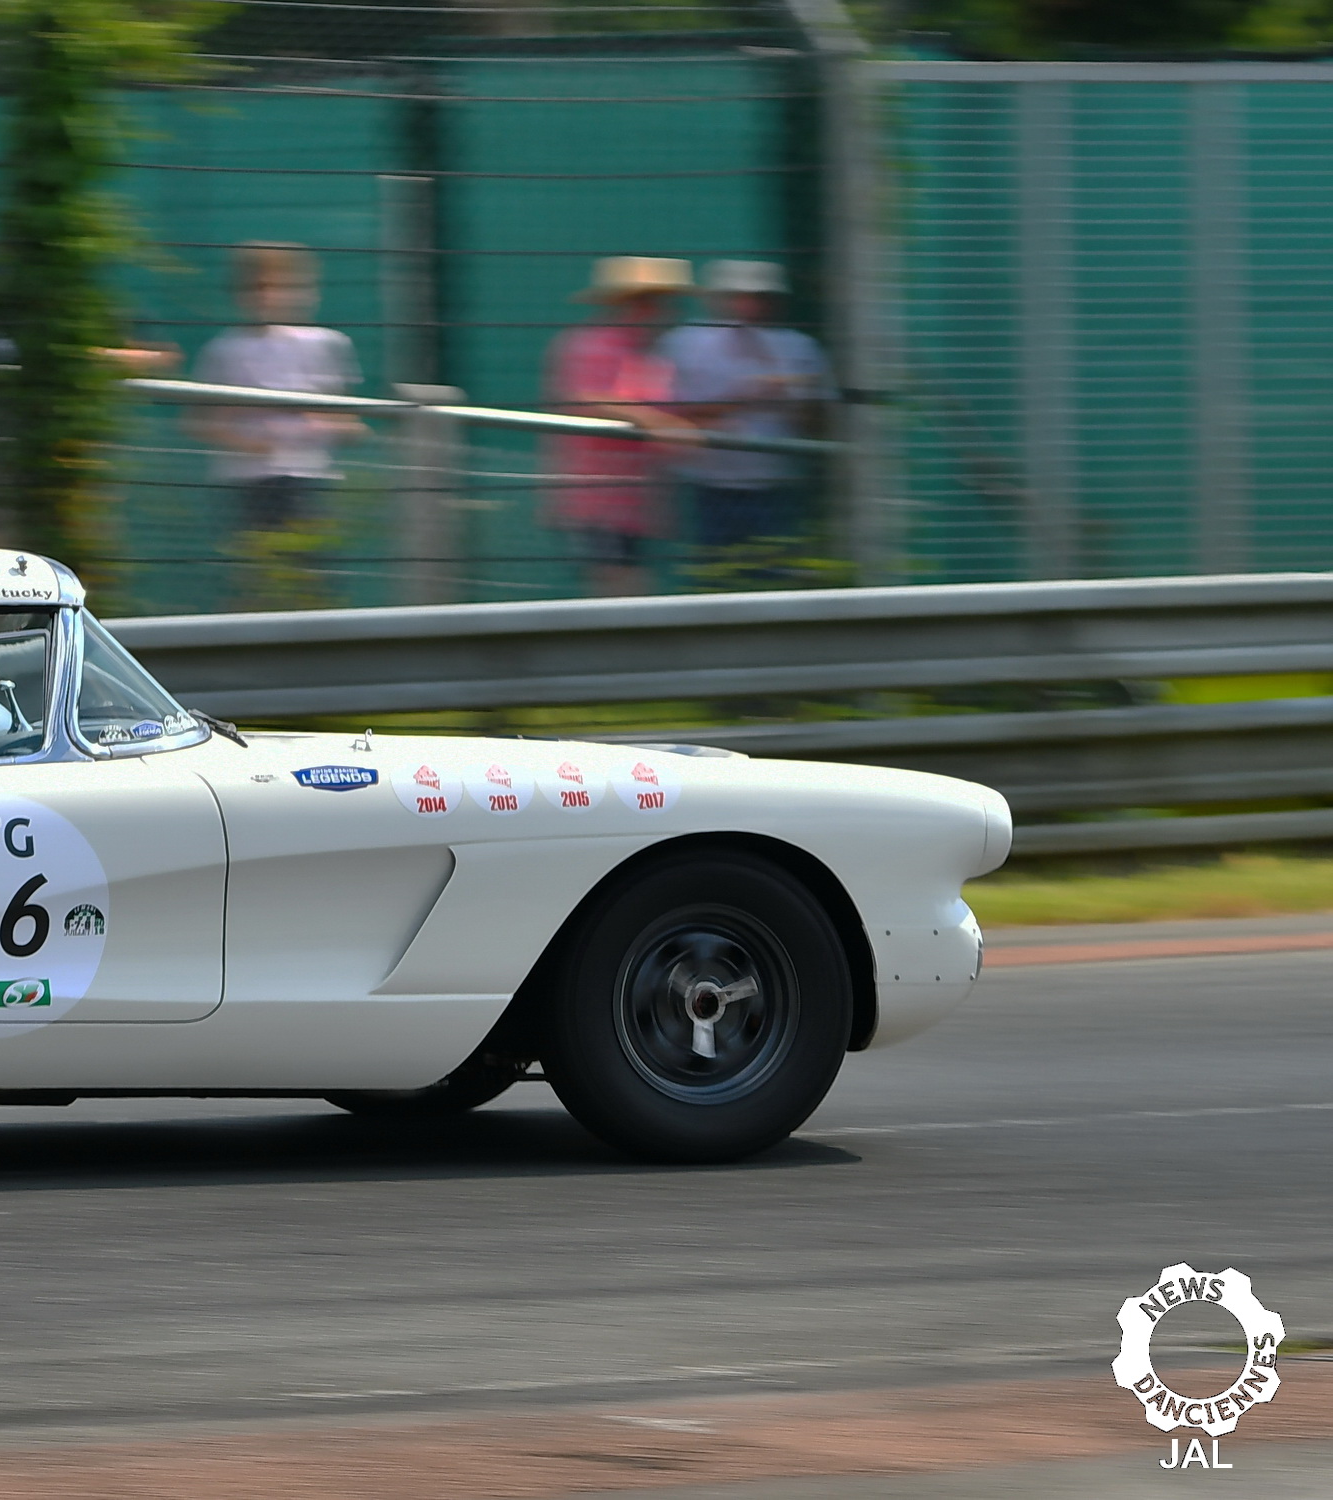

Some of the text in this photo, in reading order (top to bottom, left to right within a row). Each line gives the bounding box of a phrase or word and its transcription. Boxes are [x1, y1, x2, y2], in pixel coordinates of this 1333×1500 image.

[301, 771, 372, 785] LEGENDS
[416, 796, 447, 813] 2014
[489, 794, 518, 811] 2013
[560, 790, 590, 807] 2015
[636, 792, 664, 810] 2017
